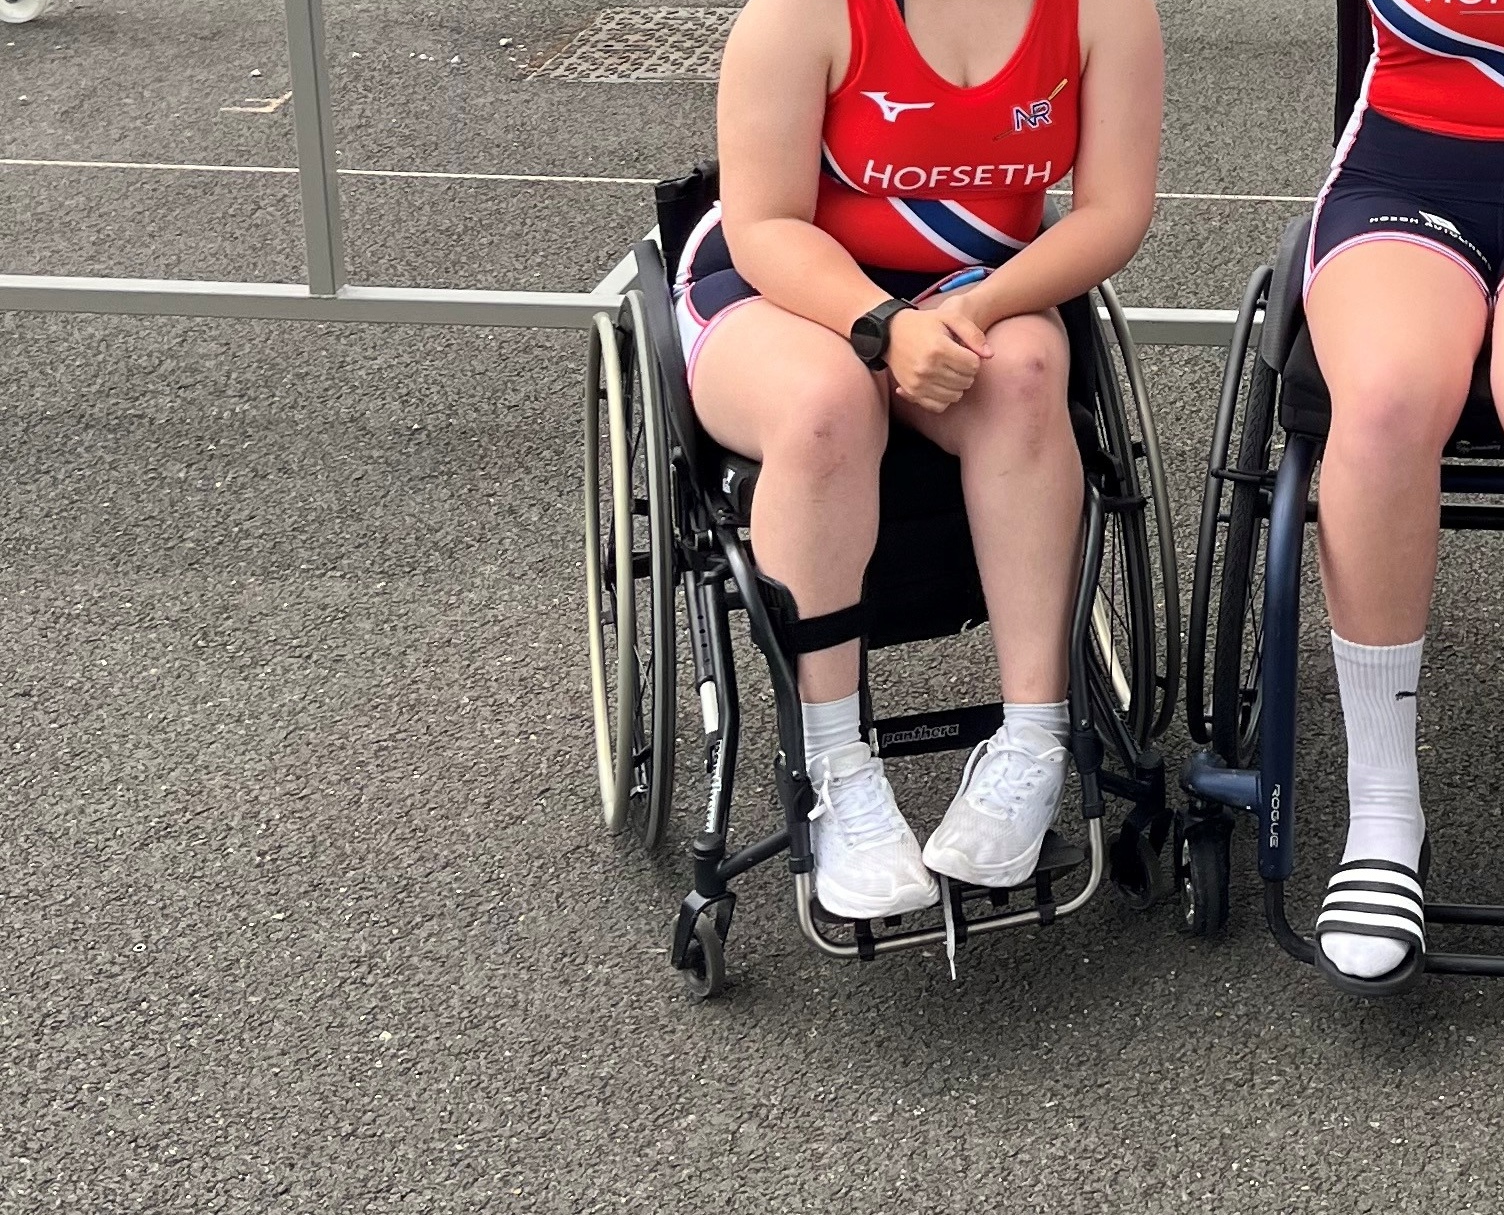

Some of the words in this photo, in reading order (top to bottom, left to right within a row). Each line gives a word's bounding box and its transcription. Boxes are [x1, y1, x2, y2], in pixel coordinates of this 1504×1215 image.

[1013, 99, 1053, 132] NR
[863, 159, 1052, 191] HOFSETH
[881, 723, 960, 748] panthera
[1269, 783, 1281, 848] ROGUE
